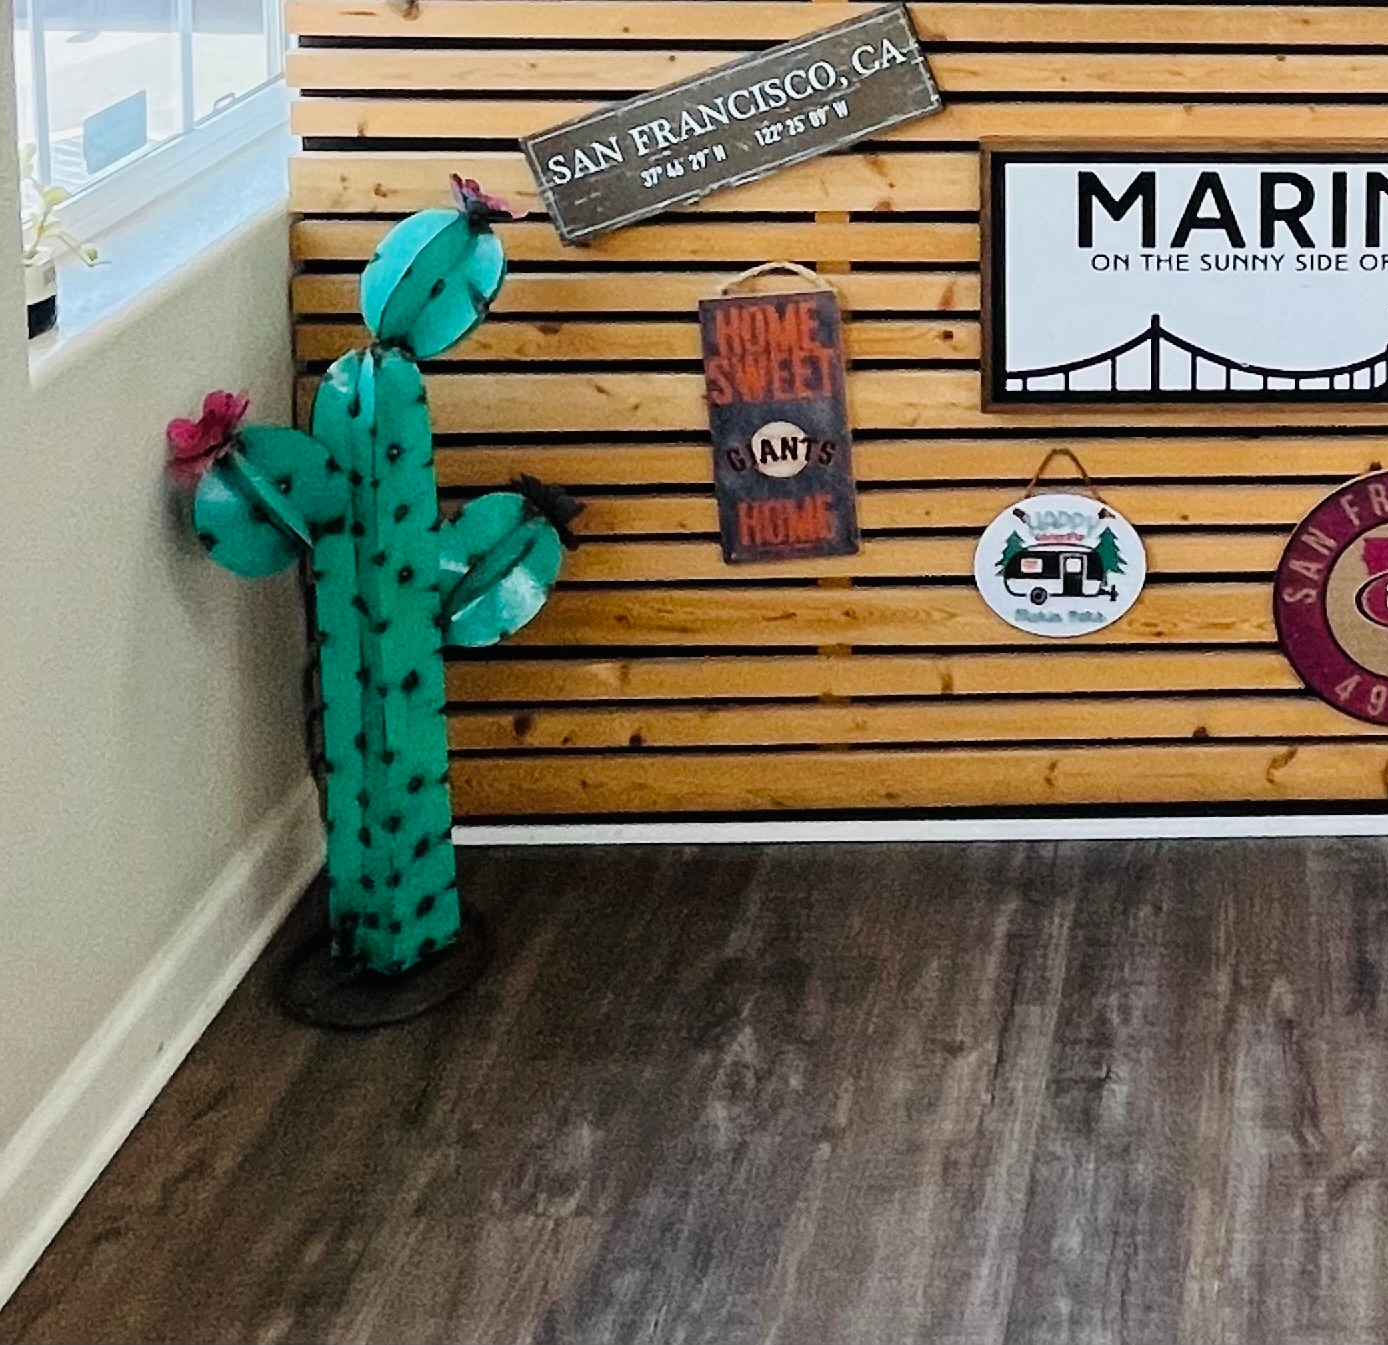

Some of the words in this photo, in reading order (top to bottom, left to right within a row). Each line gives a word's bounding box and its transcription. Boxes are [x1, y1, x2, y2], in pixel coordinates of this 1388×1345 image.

[547, 136, 625, 185] SAN
[628, 61, 849, 158] FRANCISCO,
[1091, 253, 1130, 272] ON
[1140, 253, 1190, 272] THE
[1200, 253, 1286, 272] SUNNY
[1295, 253, 1349, 272] SIDE
[714, 300, 820, 354] HOME
[706, 346, 834, 406] SWEET
[726, 435, 836, 473] GIANTS
[737, 492, 837, 547] HOME
[1282, 526, 1338, 605] SAN
